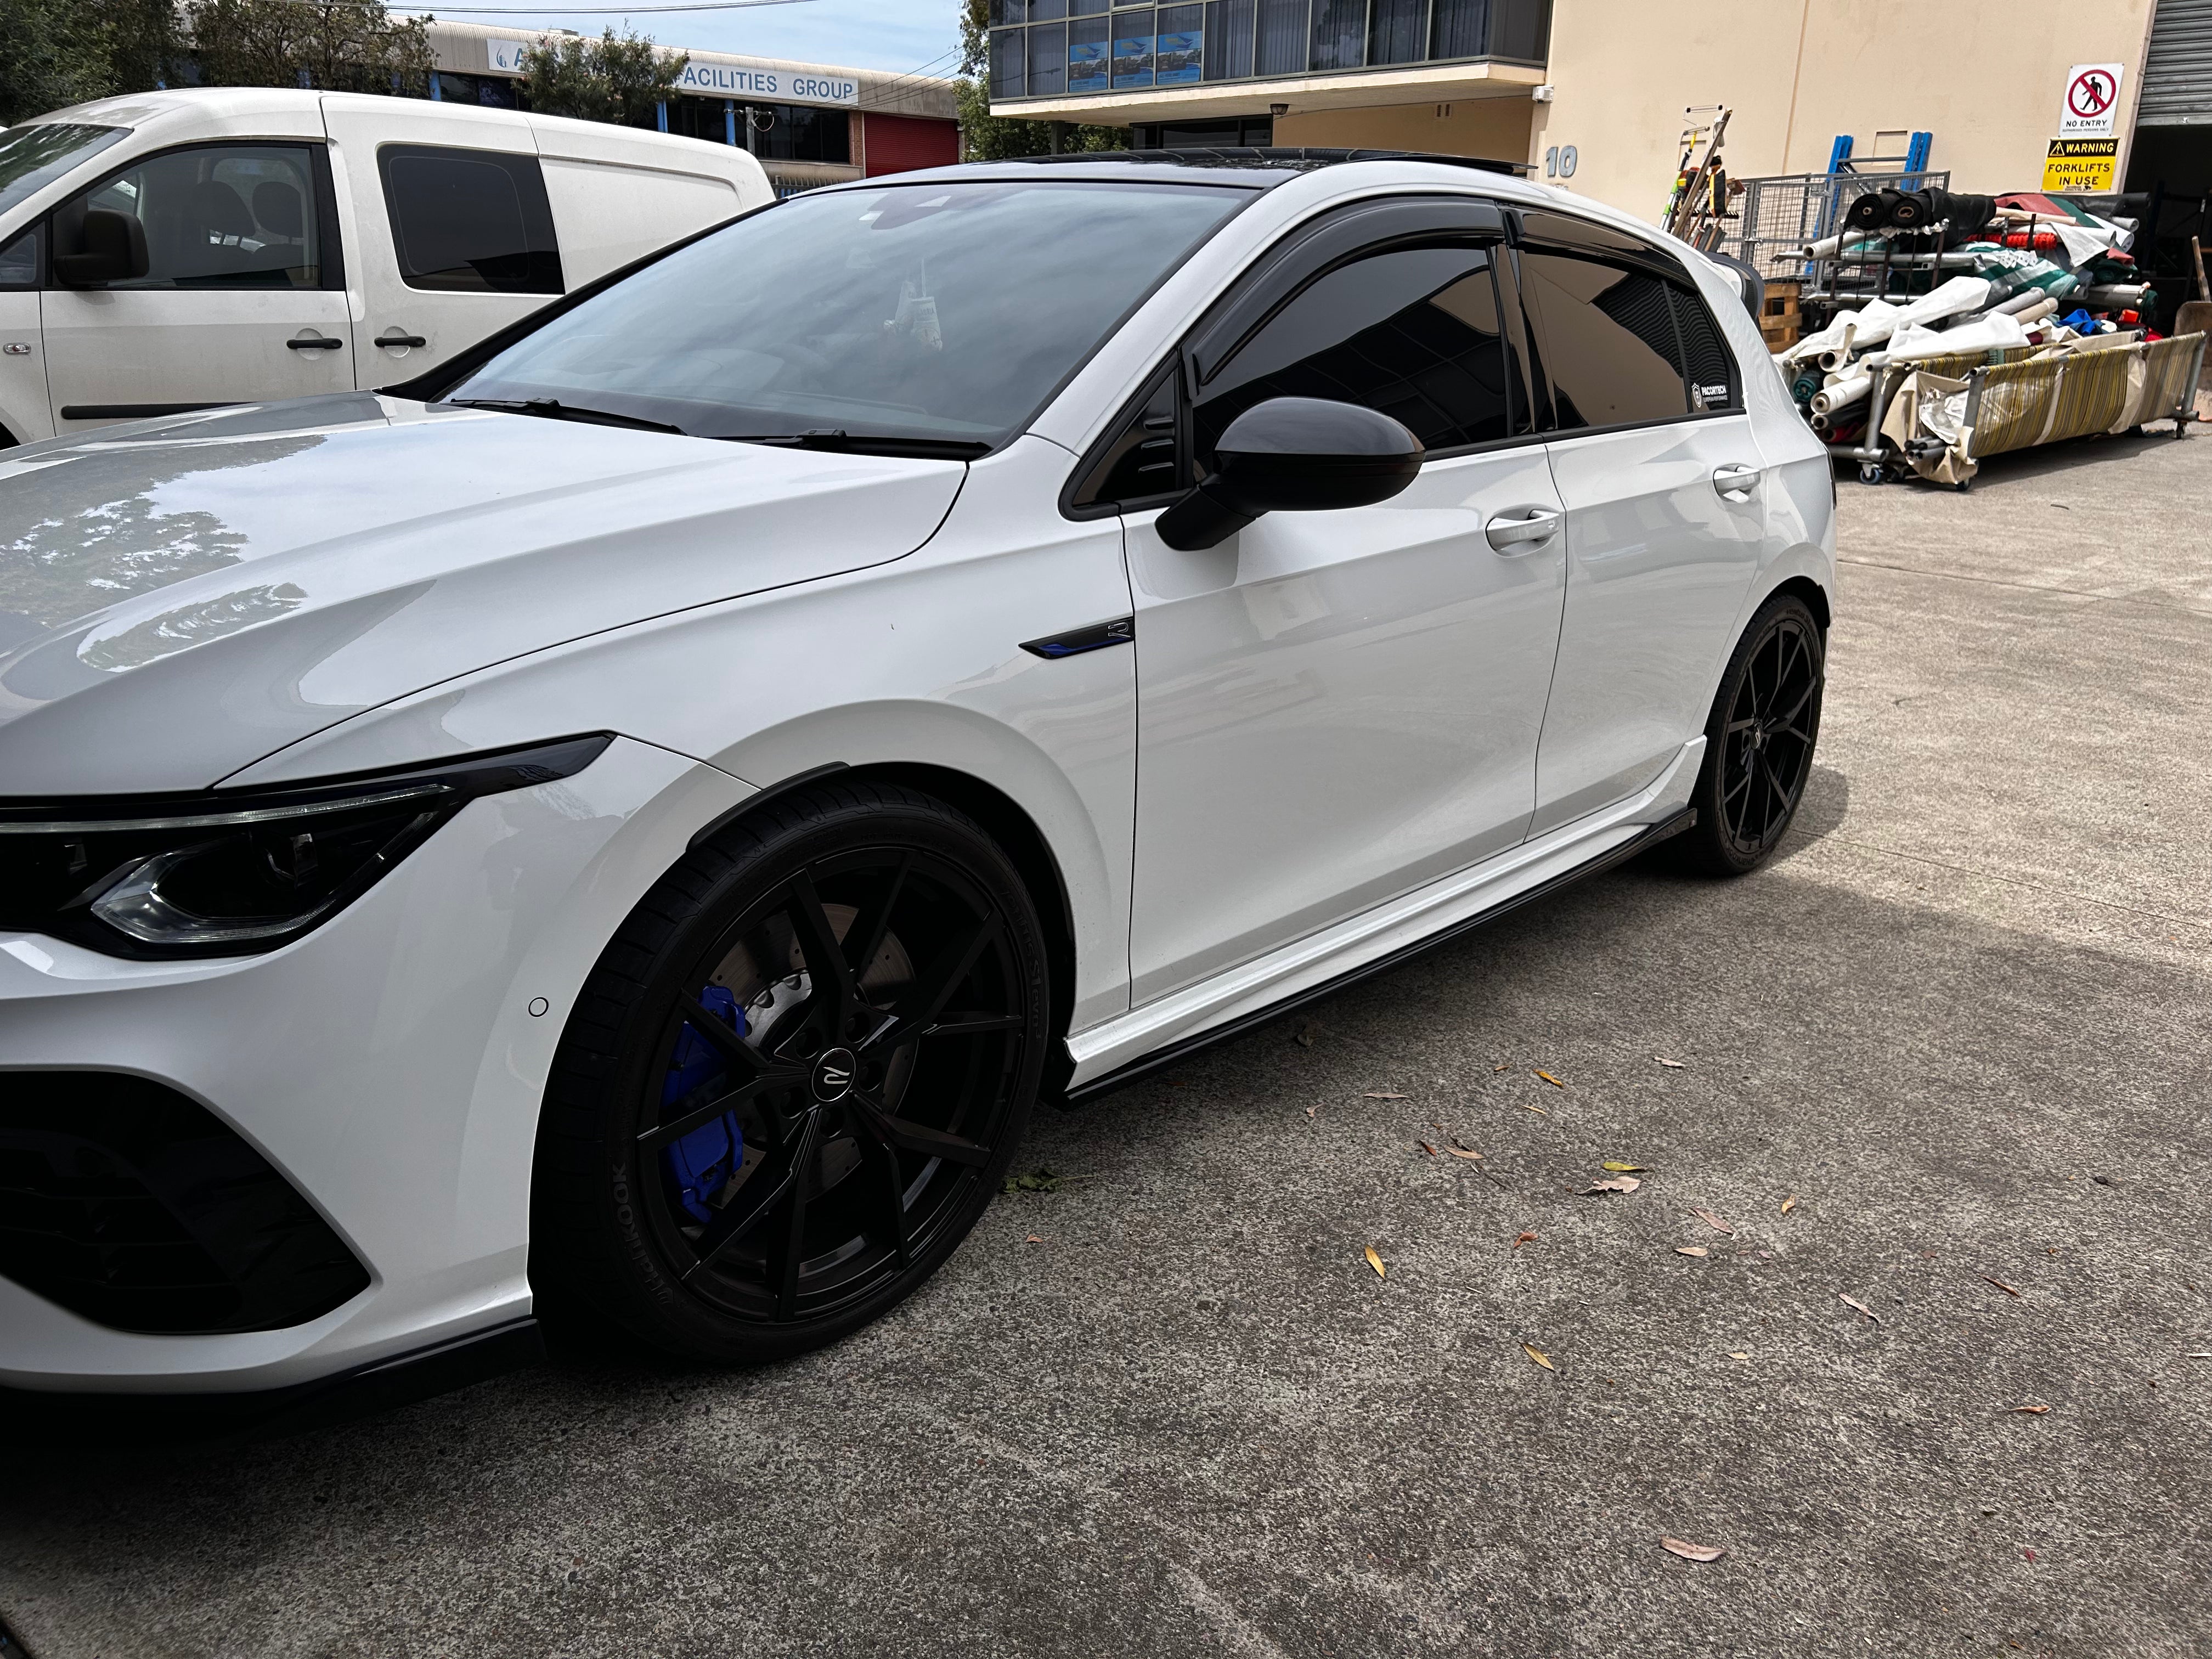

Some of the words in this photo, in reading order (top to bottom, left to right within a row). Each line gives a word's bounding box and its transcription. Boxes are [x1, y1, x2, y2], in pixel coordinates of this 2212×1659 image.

[683, 66, 777, 93] ACILITIES
[793, 78, 853, 99] GROUP
[2066, 143, 2114, 154] WARNING
[1546, 145, 1577, 177] 10
[2047, 163, 2111, 173] FORKLIFTS
[2059, 177, 2071, 185] IN
[2075, 176, 2099, 185] USE
